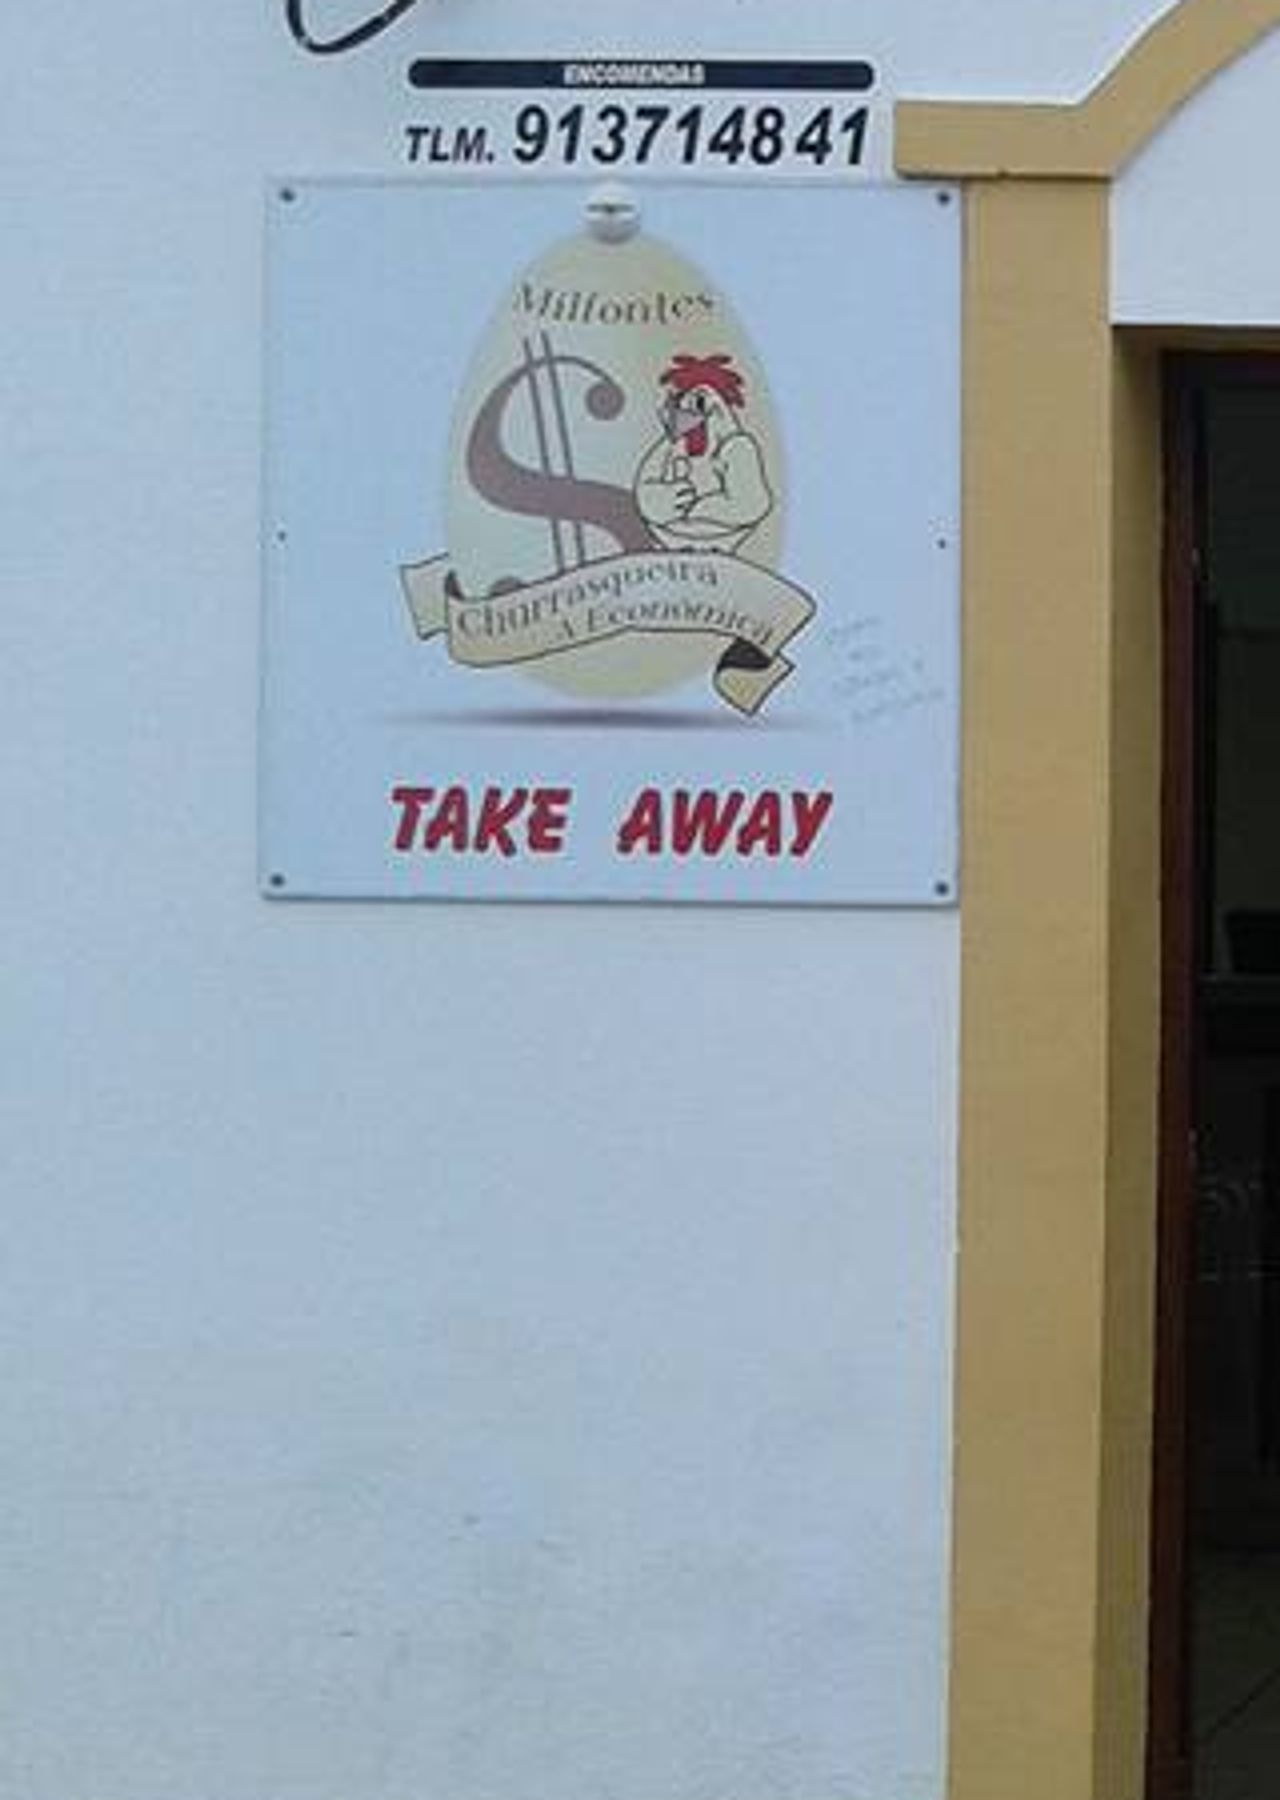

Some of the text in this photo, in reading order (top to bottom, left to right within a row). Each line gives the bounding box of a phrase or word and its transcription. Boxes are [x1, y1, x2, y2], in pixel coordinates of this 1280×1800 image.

[563, 63, 706, 85] ENCOMENDAS
[405, 104, 871, 166] TLM. 913714841
[511, 283, 714, 326] Milfontes
[456, 559, 720, 641] Churrasqueira
[391, 785, 834, 858] TAKE AWAY
